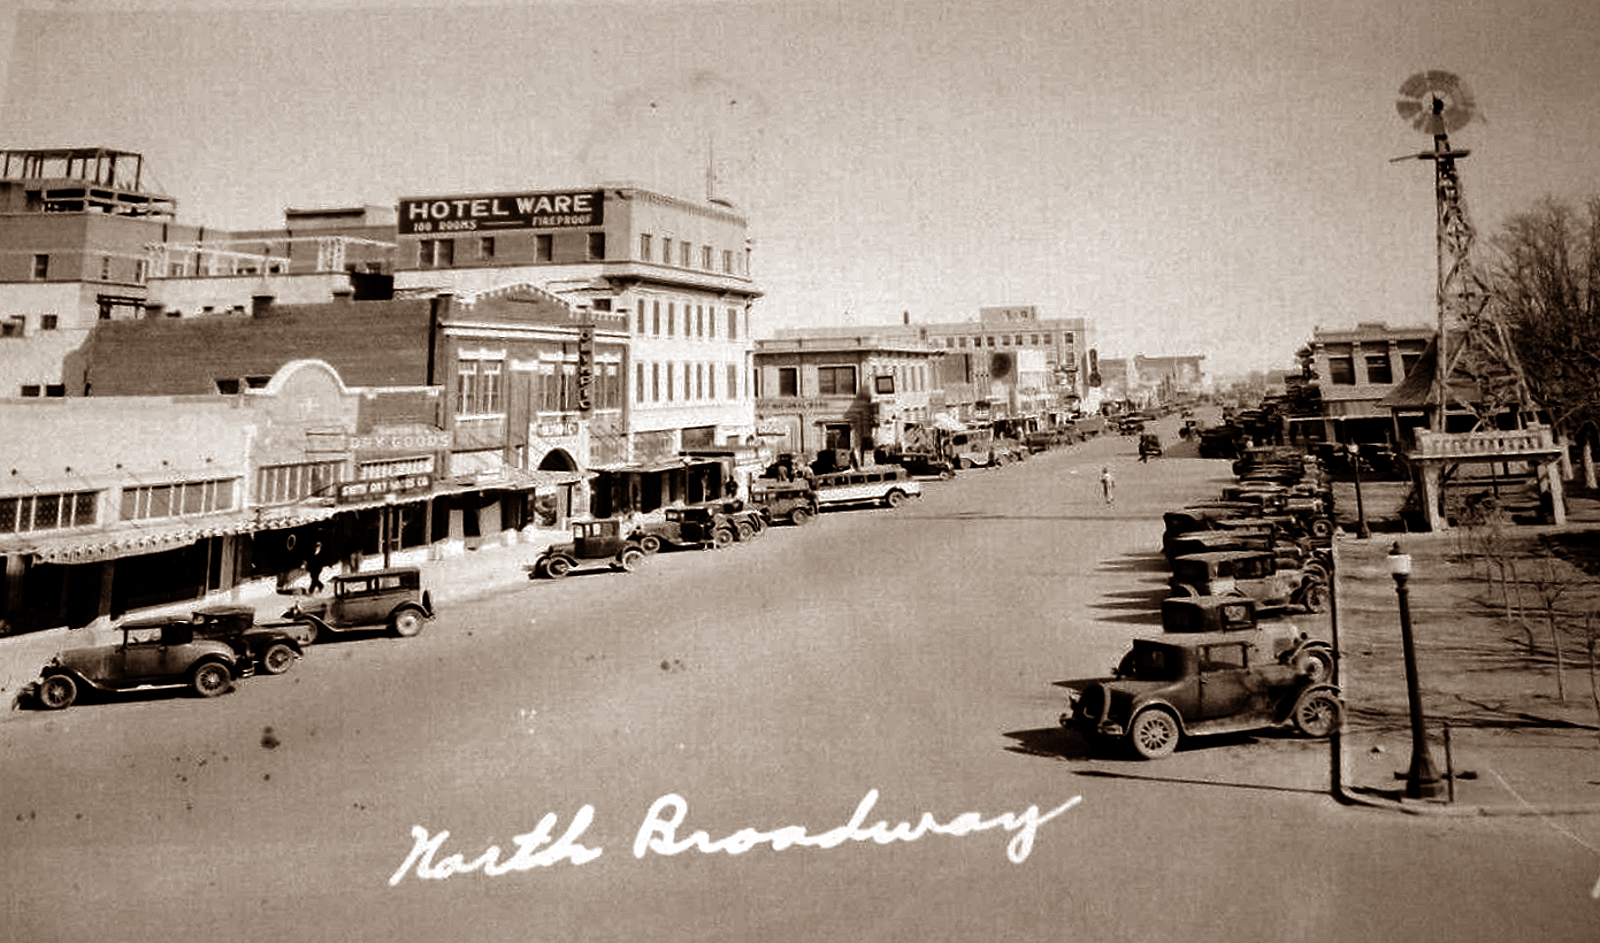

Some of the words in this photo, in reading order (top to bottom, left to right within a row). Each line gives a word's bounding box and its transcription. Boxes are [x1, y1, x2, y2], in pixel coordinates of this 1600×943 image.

[409, 200, 509, 219] HOTEL
[516, 195, 593, 214] WARE
[413, 222, 432, 232] 100
[439, 220, 477, 231] ROOMS
[532, 214, 592, 226] FIREPROOF
[391, 435, 449, 449] GOODS
